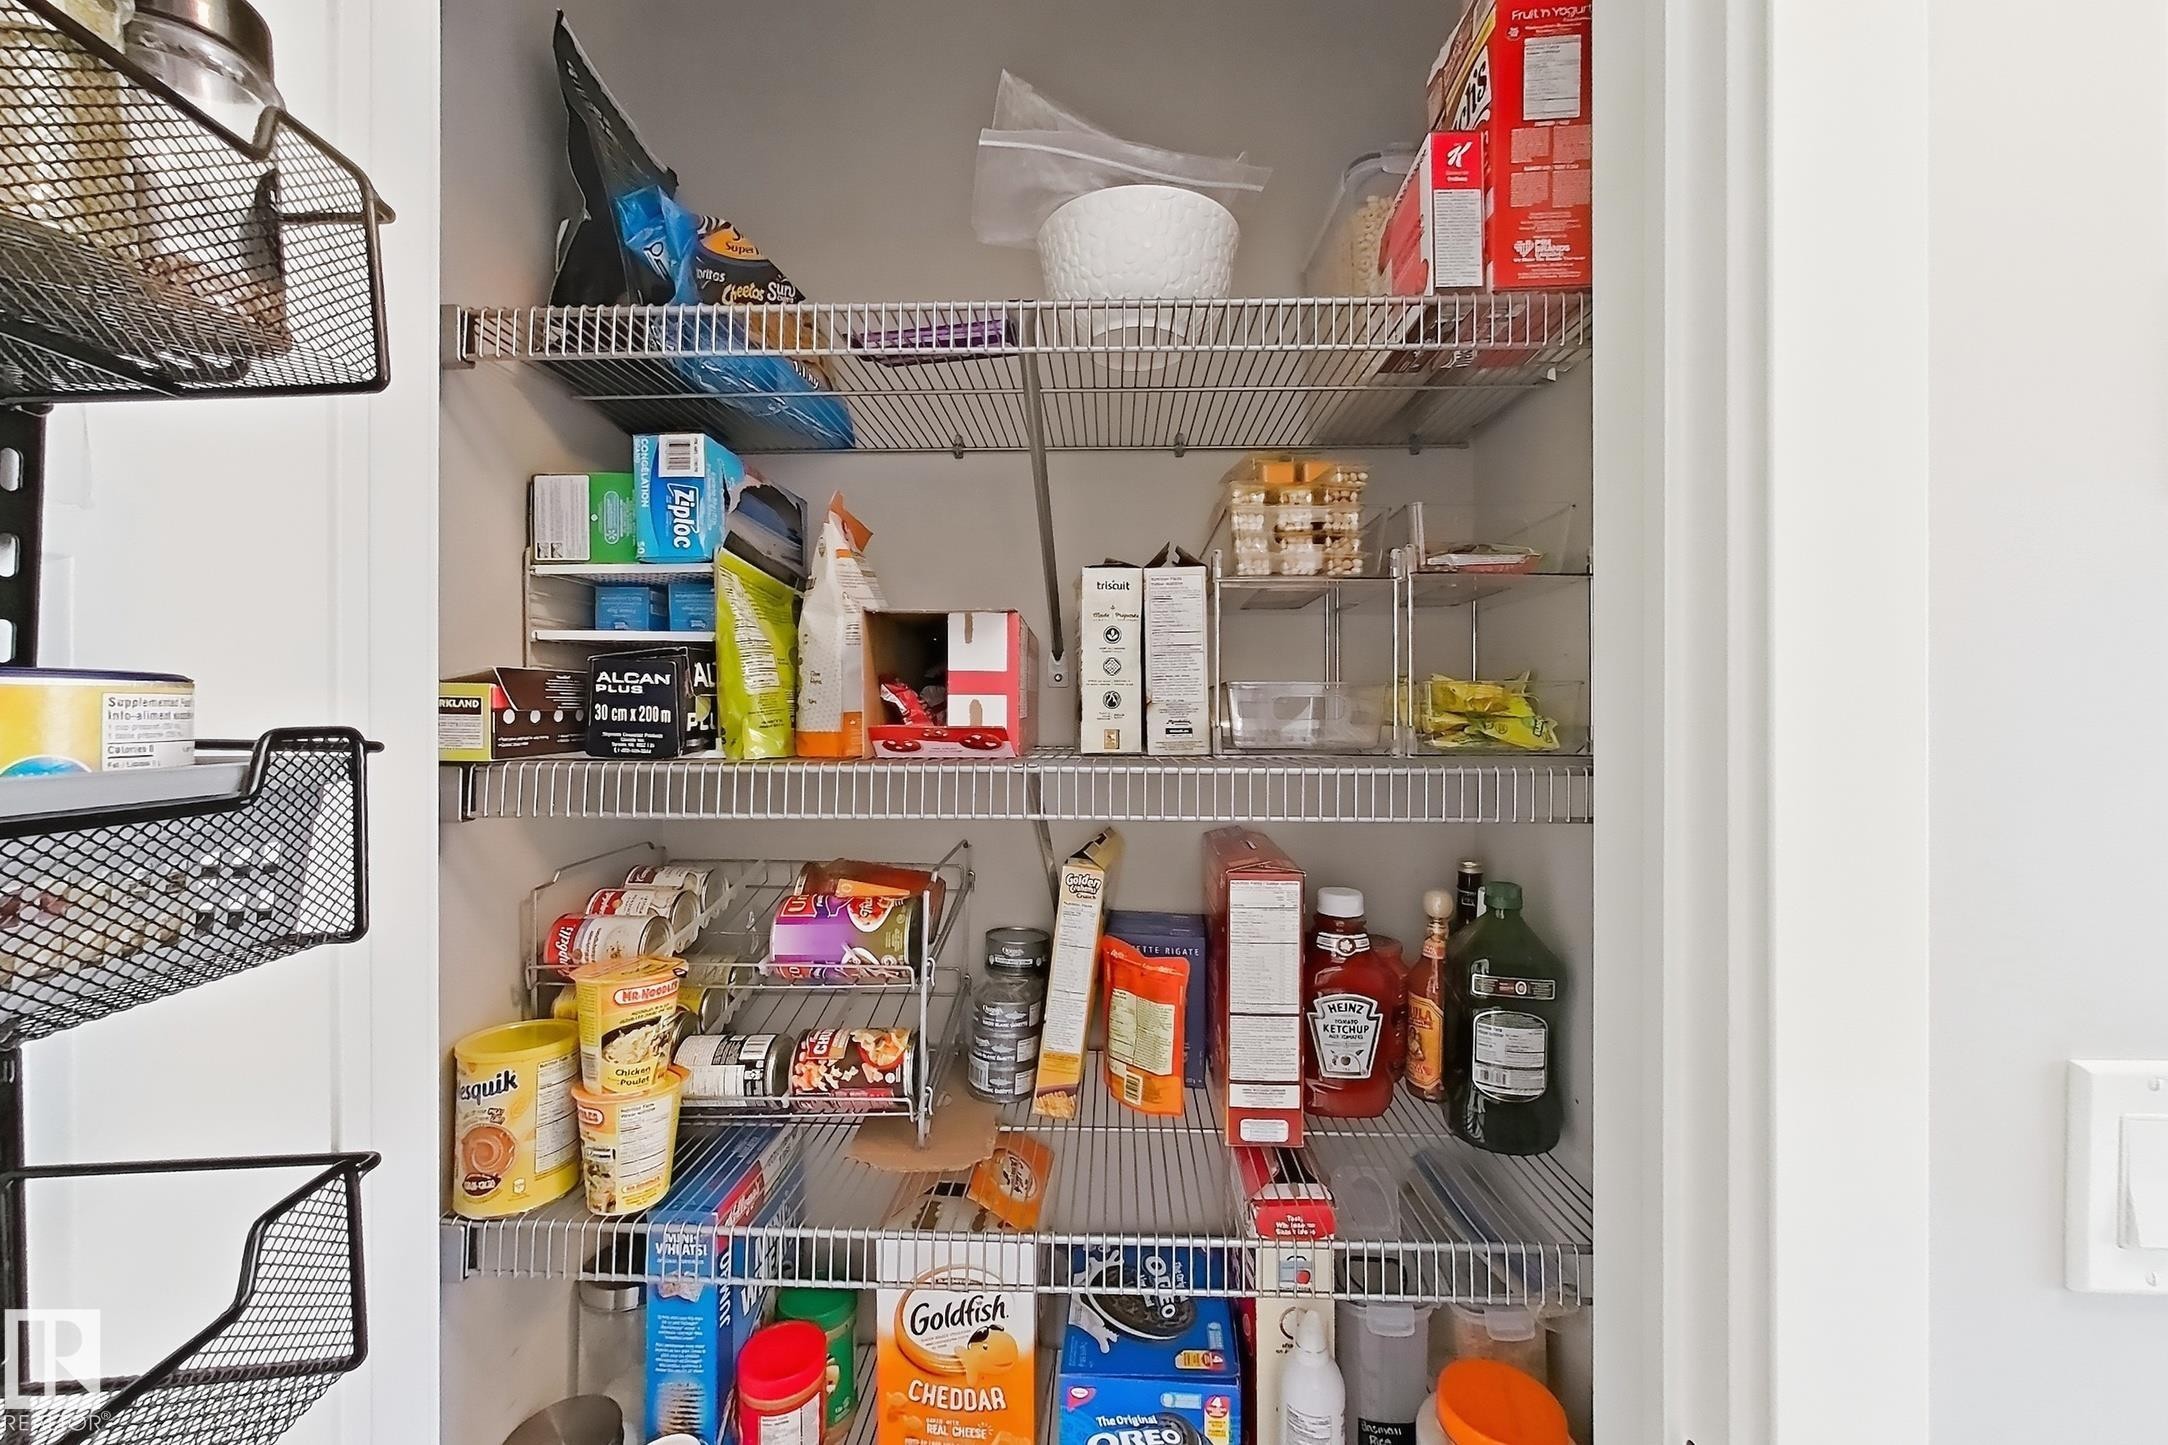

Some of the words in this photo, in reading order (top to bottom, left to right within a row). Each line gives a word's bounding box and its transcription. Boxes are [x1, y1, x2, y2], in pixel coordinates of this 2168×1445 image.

[1512, 9, 1539, 20] Fruit
[725, 242, 754, 255] Super
[696, 268, 726, 283] oritos
[721, 283, 765, 304] Cheetos
[767, 281, 796, 301] Sun
[641, 438, 650, 508] CONGÉLATION
[667, 489, 696, 549] Ziploc
[1096, 580, 1130, 591] triscuit
[596, 672, 671, 685] ALCAN
[595, 684, 645, 694] PLUS
[439, 699, 480, 708] RKLAND
[594, 704, 609, 721] 30
[611, 707, 628, 722] cm
[629, 708, 637, 722] x
[638, 704, 659, 723] 200
[660, 709, 671, 724] m
[107, 745, 147, 754] Calories
[1065, 872, 1102, 889] Golden
[555, 926, 574, 976] mpbell's
[1165, 947, 1200, 956] RIGATE
[1327, 1003, 1365, 1014] HEINZ
[1323, 1024, 1370, 1034] KETCHUP
[615, 1066, 651, 1077] Chicken
[460, 1070, 519, 1106] esquik
[620, 1076, 650, 1087] Poulet
[910, 1293, 1006, 1336] Goldfish
[908, 1379, 1007, 1412] CHEDDAR
[1211, 1396, 1223, 1408] 4
[1096, 1416, 1117, 1427] The
[1117, 1414, 1158, 1428] Original
[926, 1424, 948, 1436] REAL
[951, 1426, 987, 1439] CHEESE
[1087, 1429, 1182, 1445] OREO
